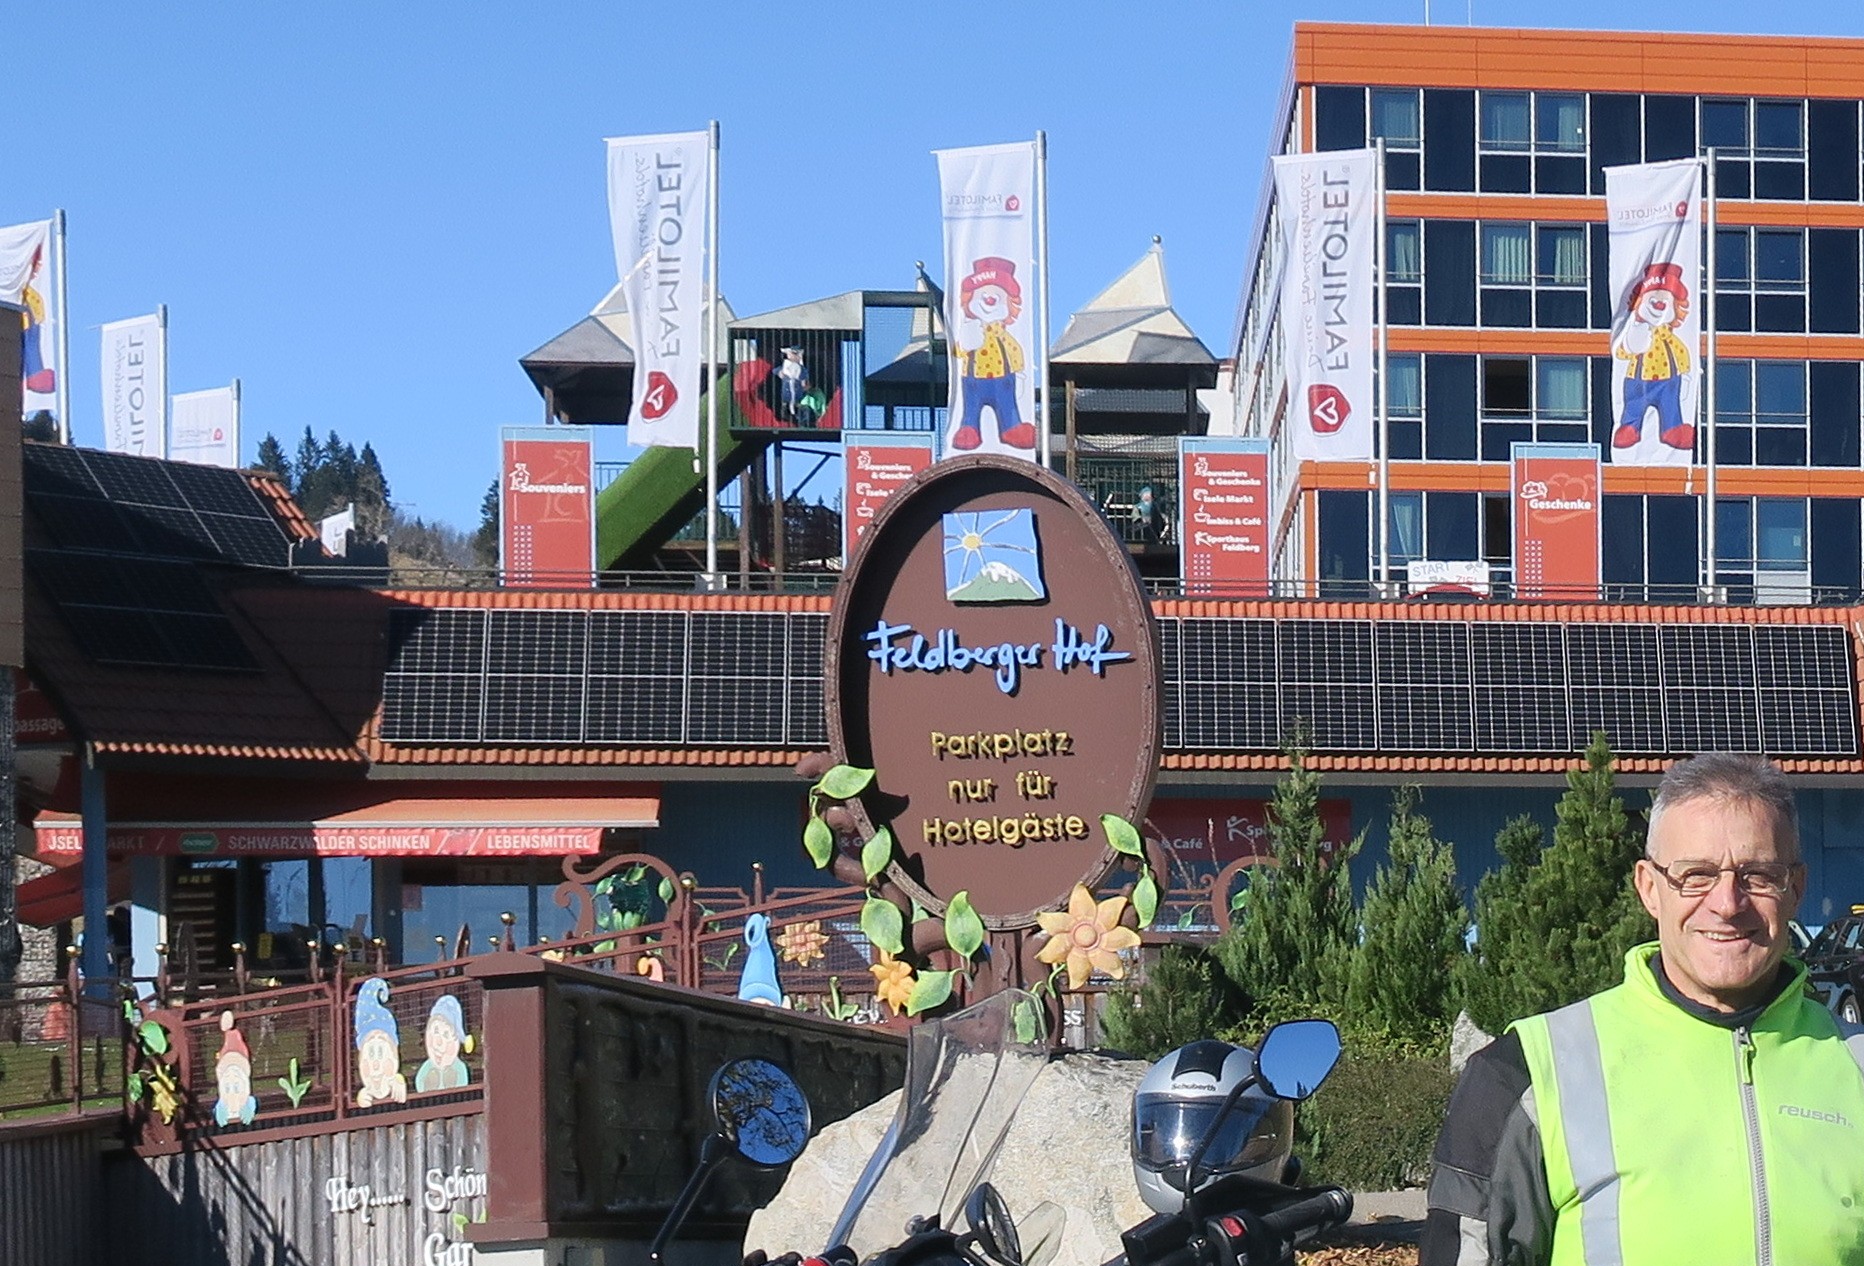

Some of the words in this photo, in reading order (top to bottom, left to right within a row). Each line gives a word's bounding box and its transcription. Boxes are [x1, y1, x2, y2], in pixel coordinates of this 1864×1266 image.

[1529, 499, 1592, 510] Geschenke
[1413, 562, 1451, 577] START
[867, 620, 1042, 693] Feldberger
[1052, 617, 1131, 674] Hof
[931, 728, 1070, 757] Parkplatz
[948, 777, 992, 800] nur
[1016, 770, 1052, 797] für
[922, 813, 1084, 845] Hotelgäste
[359, 834, 429, 850] SCHINKEN
[487, 834, 590, 849] LEBENSMITTEL
[1173, 838, 1202, 850] Café
[1778, 1104, 1847, 1126] reusch
